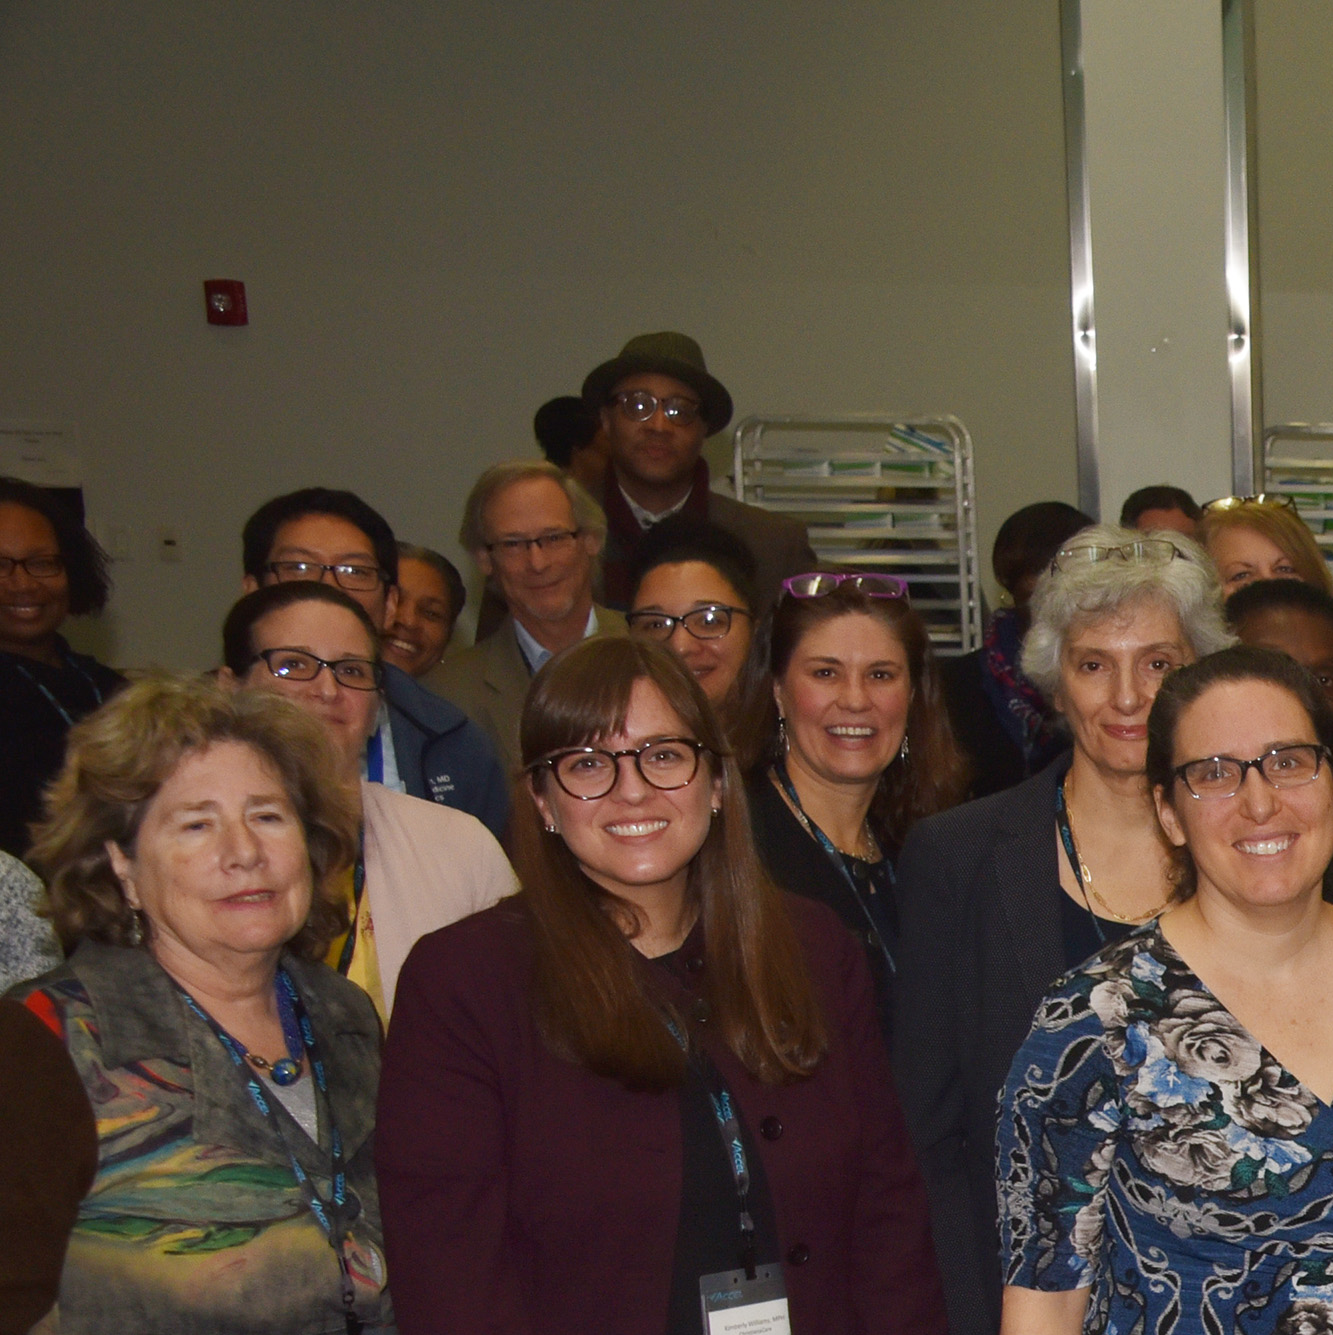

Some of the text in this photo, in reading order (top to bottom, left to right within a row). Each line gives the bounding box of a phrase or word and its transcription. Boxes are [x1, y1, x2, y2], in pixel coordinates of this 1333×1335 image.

[436, 775, 450, 783] MD
[432, 784, 455, 793] dicine
[732, 1146, 745, 1175] ACCEL
